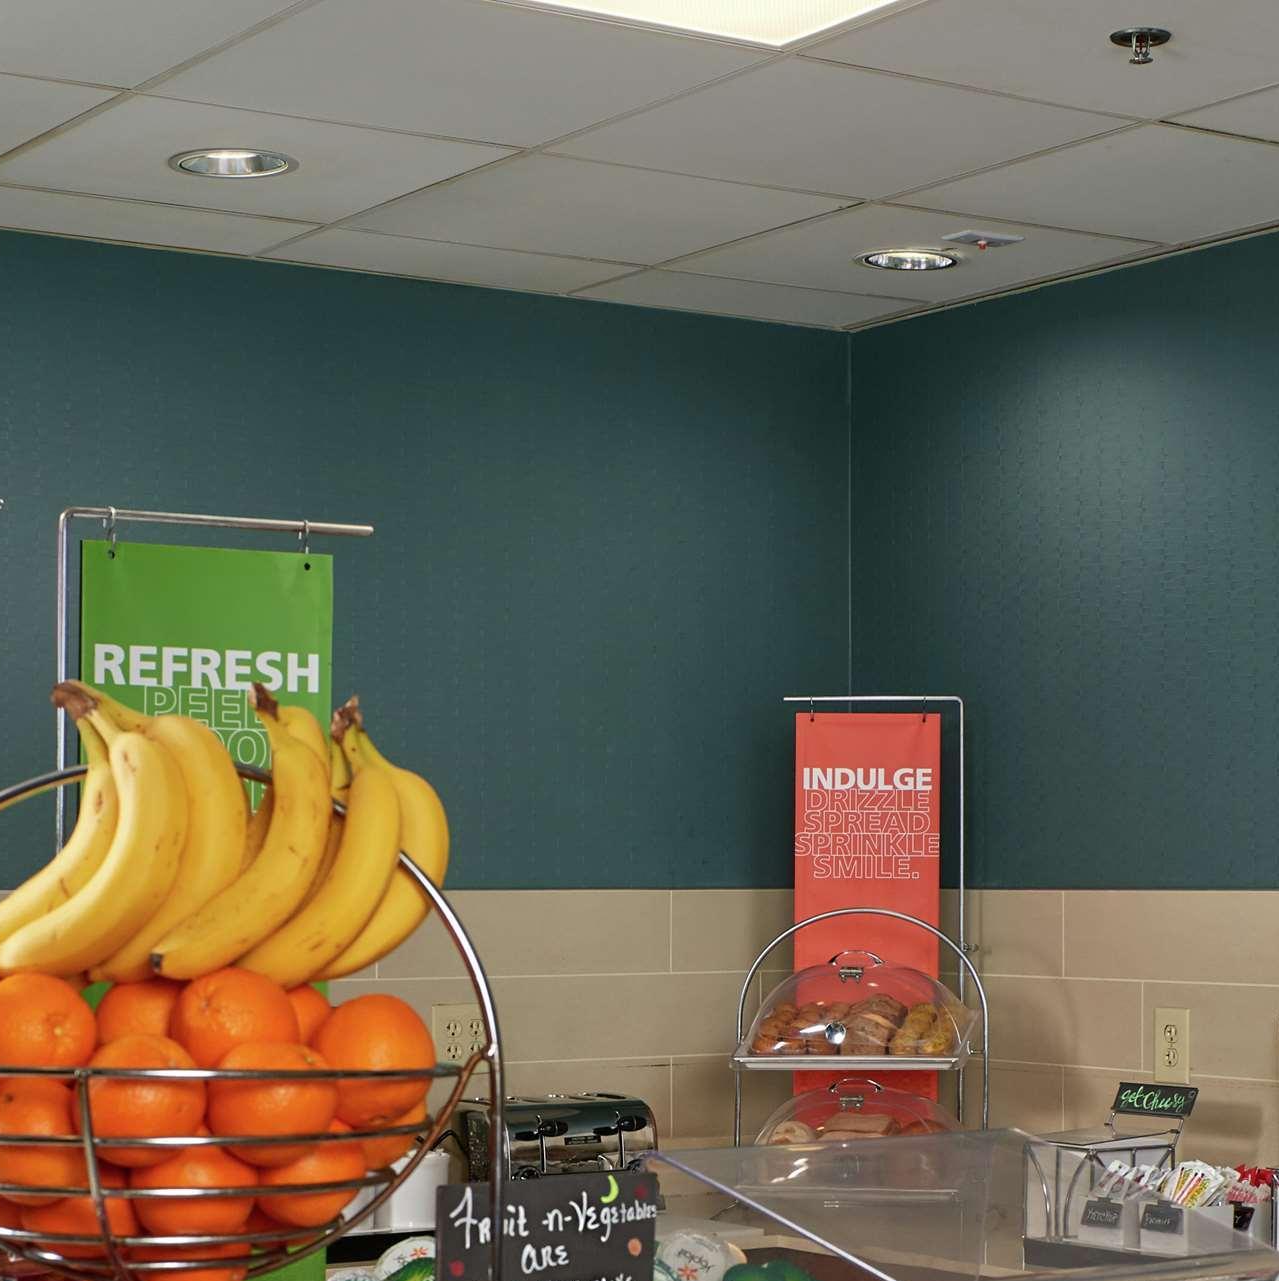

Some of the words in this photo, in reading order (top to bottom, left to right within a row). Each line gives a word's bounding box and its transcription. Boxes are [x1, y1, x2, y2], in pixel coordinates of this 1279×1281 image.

[93, 643, 320, 694] REFRESH
[802, 767, 933, 791] INDULGE
[804, 788, 930, 813] DRIZZLE
[803, 810, 931, 835] SPREAD
[794, 832, 941, 857] SPRINKLE
[813, 854, 920, 880] SMILE.
